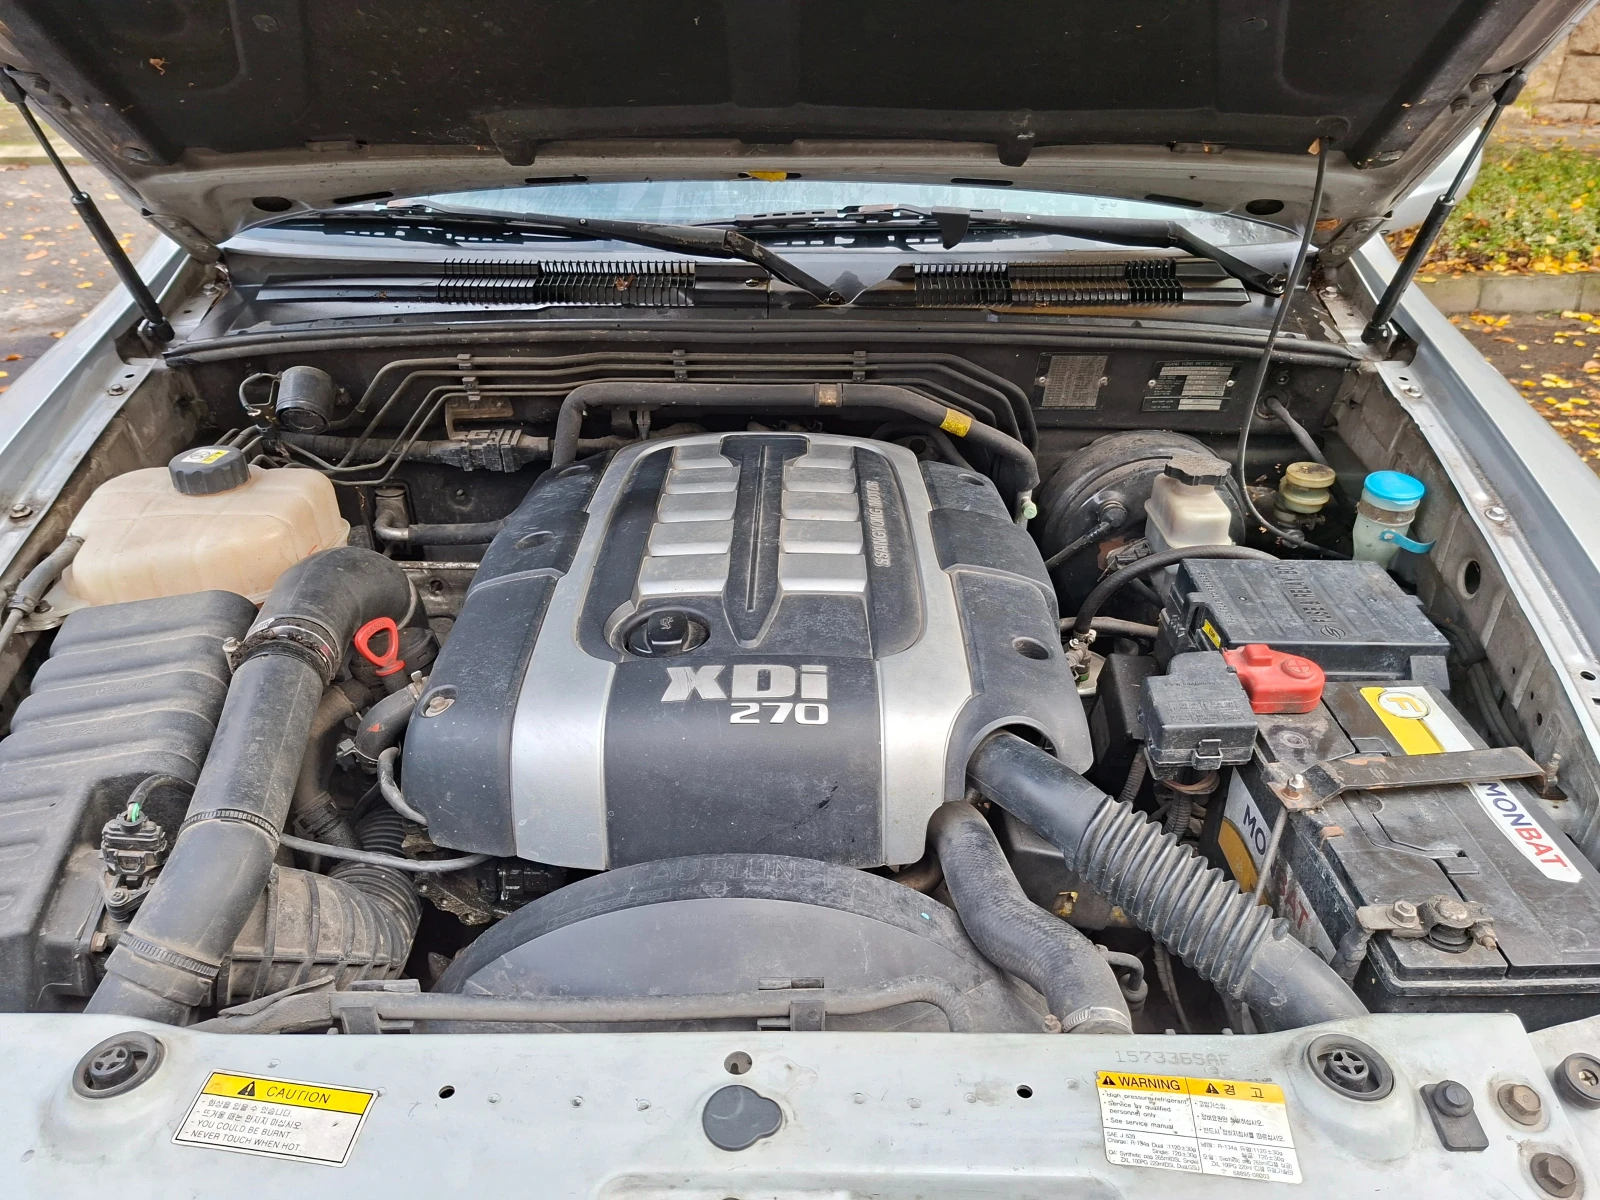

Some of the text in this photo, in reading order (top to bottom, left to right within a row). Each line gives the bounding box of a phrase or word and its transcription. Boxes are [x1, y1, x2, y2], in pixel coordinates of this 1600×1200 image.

[866, 480, 892, 568] SSANGYONG MOTOR
[661, 664, 828, 702] XDi
[730, 702, 829, 725] 270
[1477, 782, 1568, 868] MONBAT
[1118, 1076, 1181, 1091] WARNING
[1223, 1084, 1265, 1099] 경 고
[266, 1086, 331, 1104] CAUTION
[1154, 1096, 1187, 1104] refrigerant
[1107, 1100, 1132, 1108] Service
[1145, 1104, 1172, 1113] qualified
[1109, 1108, 1141, 1117] personnel
[244, 1114, 269, 1125] 만지지
[1125, 1119, 1148, 1127] service
[1150, 1122, 1174, 1130] manual
[197, 1119, 292, 1139] YOU COULD BE BURNT.
[190, 1129, 302, 1152] NEVER TOUCH WHEN HOT.
